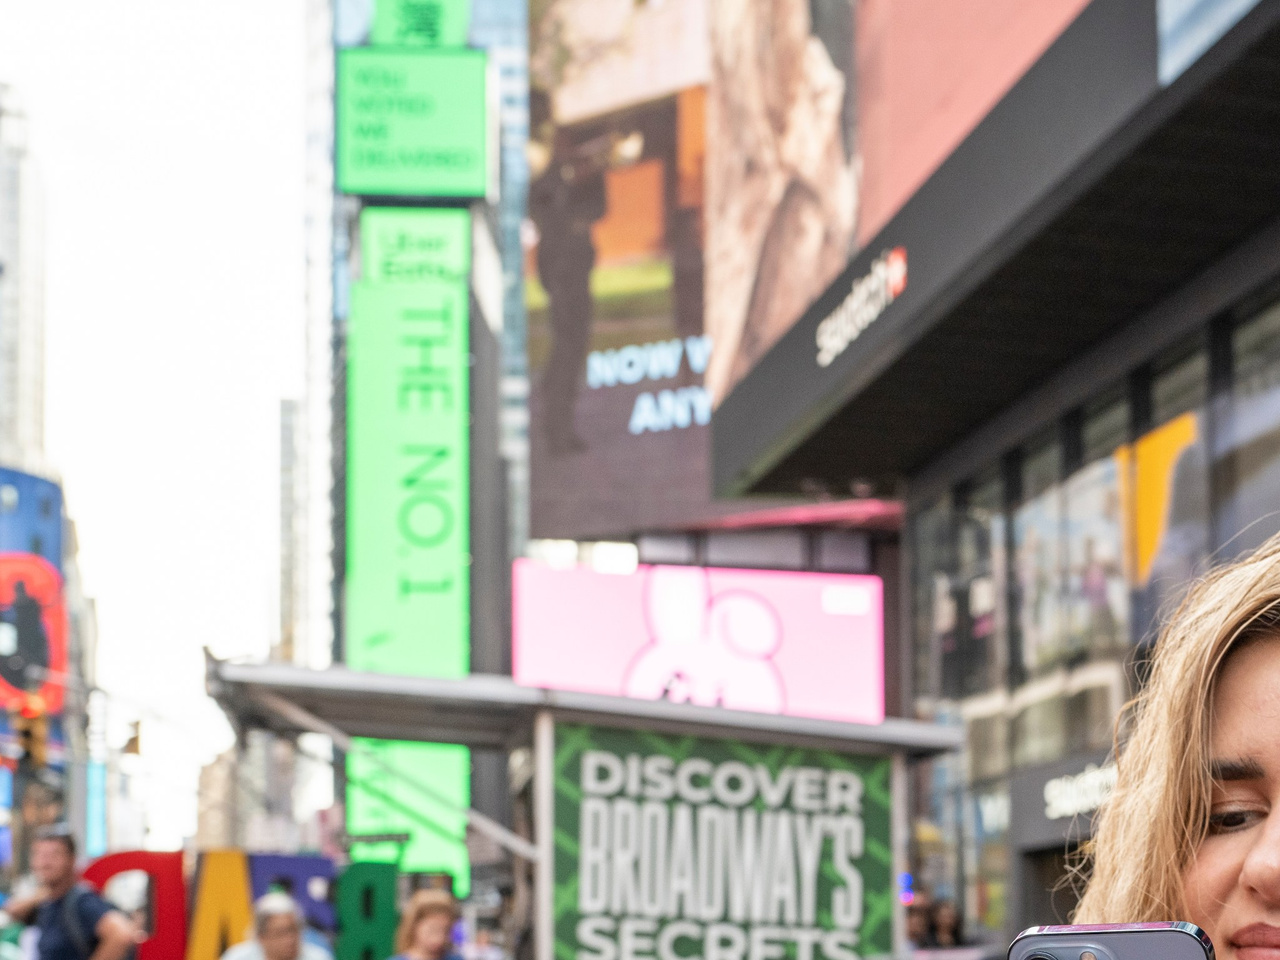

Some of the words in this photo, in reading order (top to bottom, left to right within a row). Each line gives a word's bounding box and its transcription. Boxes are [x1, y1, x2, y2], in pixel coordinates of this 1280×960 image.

[400, 304, 454, 411] THE
[586, 338, 683, 389] NOW
[581, 751, 864, 813] DISCOVER
[577, 797, 865, 929] BROADWAY'S
